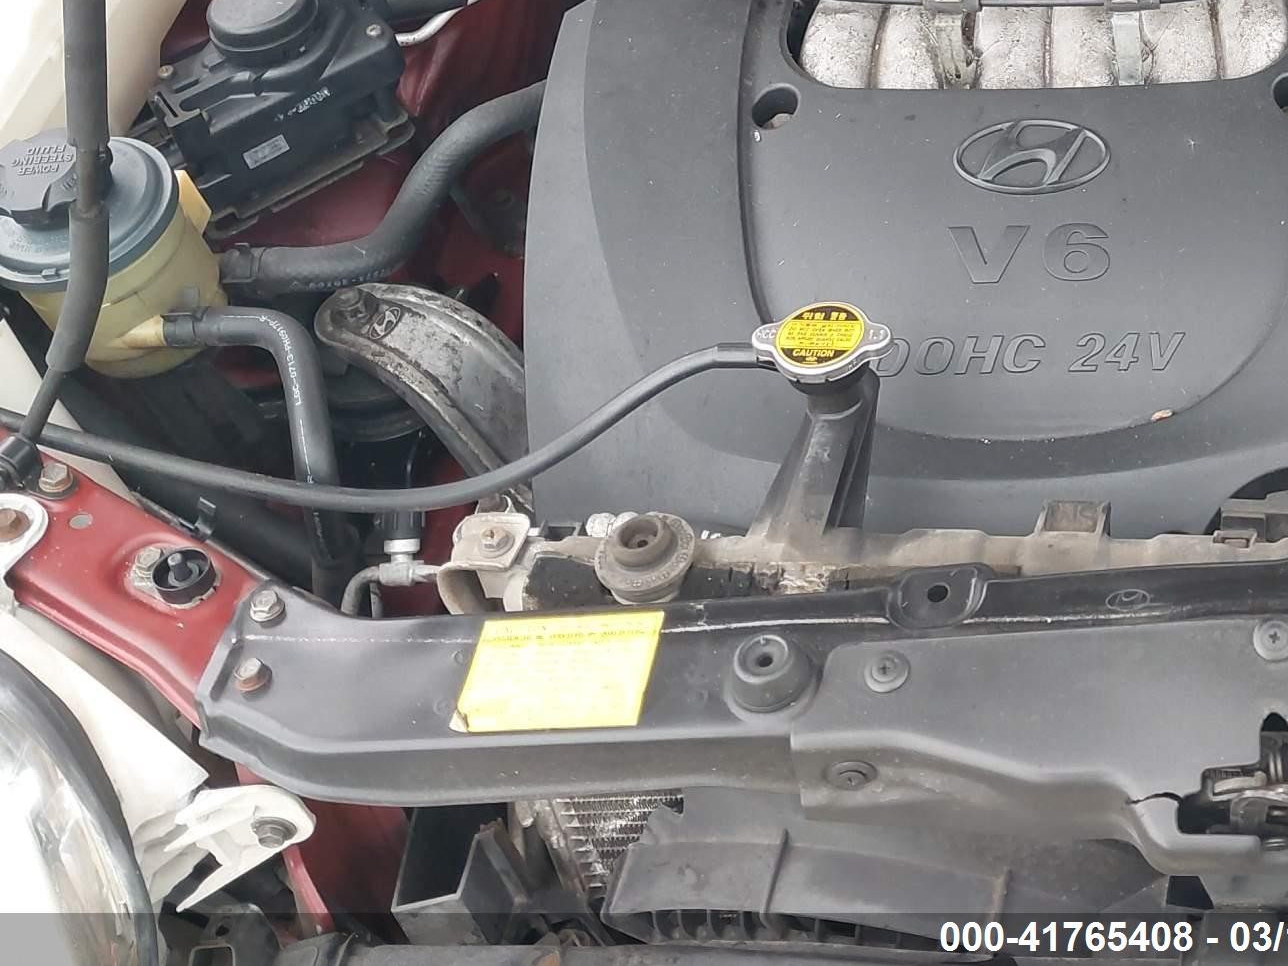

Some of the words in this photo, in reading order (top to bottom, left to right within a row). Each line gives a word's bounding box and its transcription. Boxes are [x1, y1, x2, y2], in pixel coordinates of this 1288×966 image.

[27, 144, 67, 155] FLUID
[11, 153, 74, 167] STEERING
[17, 164, 59, 176] POWER
[948, 223, 1111, 284] V6
[792, 349, 835, 357] CAUTION
[869, 334, 1046, 378] DOHC
[1068, 332, 1187, 372] 24V
